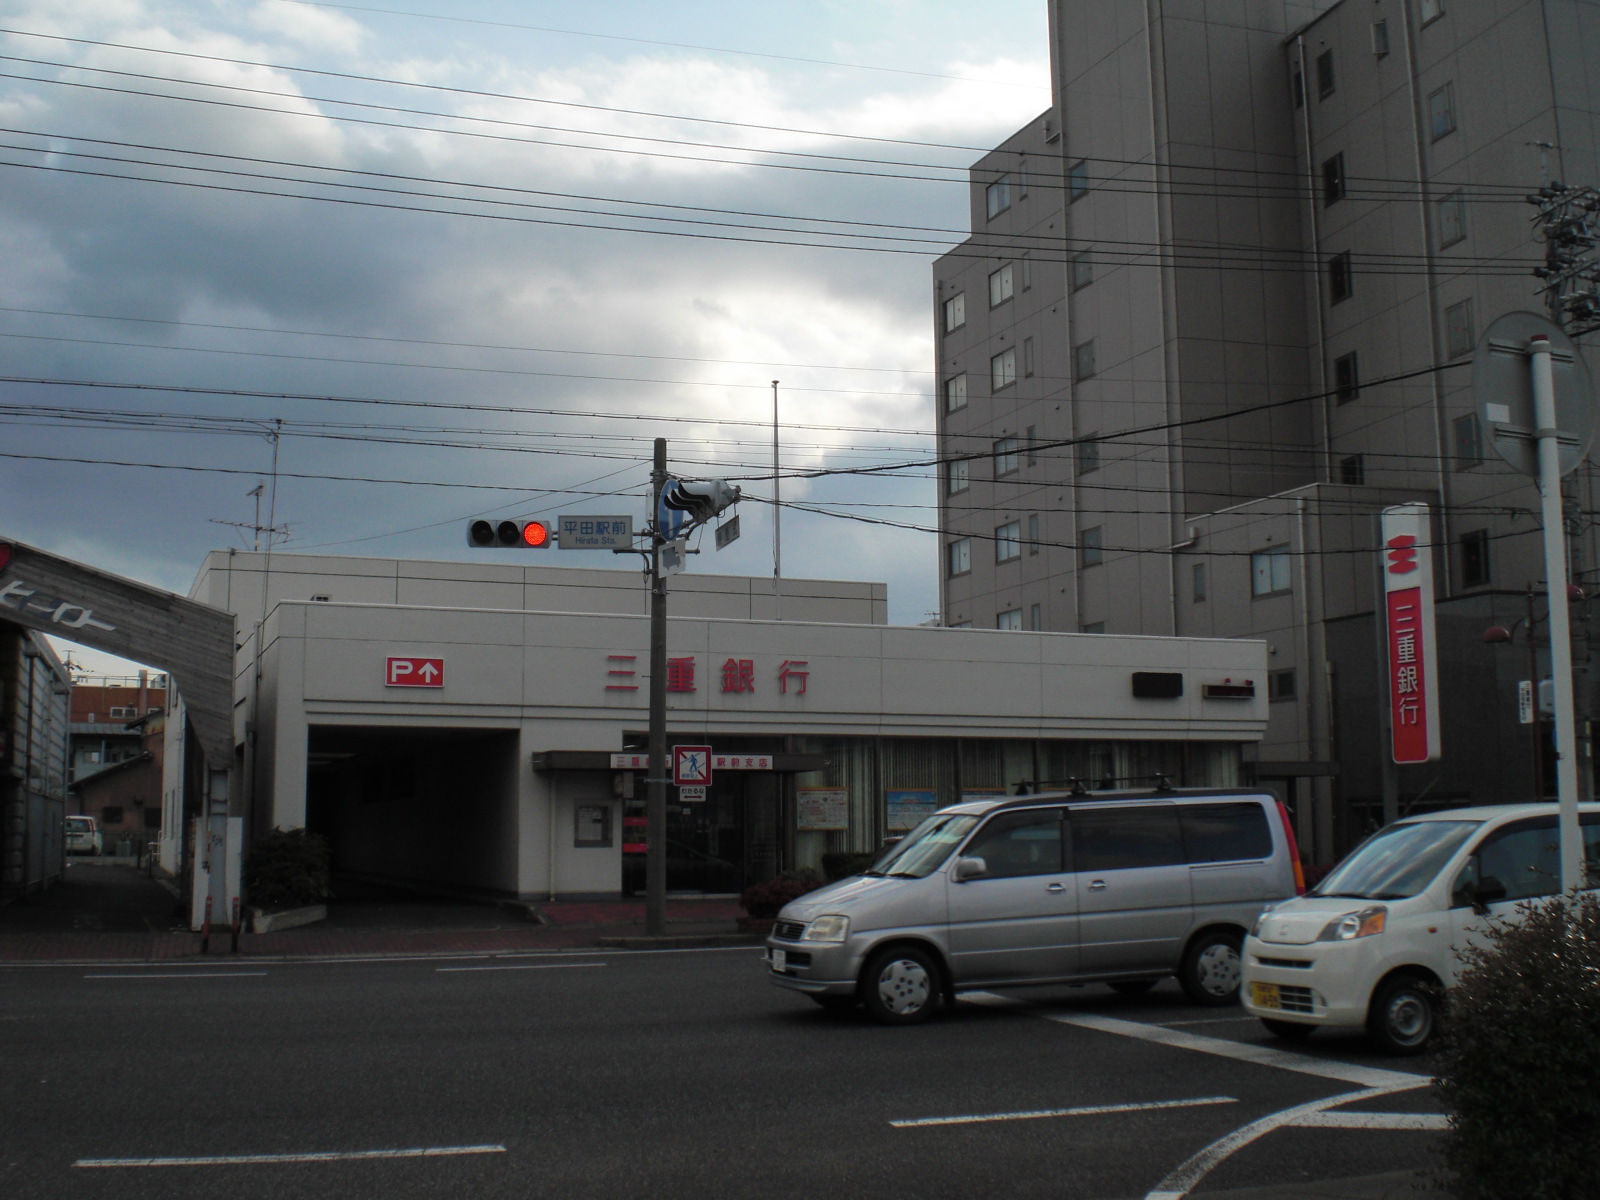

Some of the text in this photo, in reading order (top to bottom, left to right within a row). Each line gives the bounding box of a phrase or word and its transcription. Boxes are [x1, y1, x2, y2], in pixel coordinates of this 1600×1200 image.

[564, 521, 626, 535] 平田駅前
[575, 537, 598, 545] Hirata
[391, 660, 414, 682] P
[1395, 605, 1419, 725] 三重銀行
[604, 655, 810, 695] 三重銀行
[716, 757, 768, 769] 駅前支店
